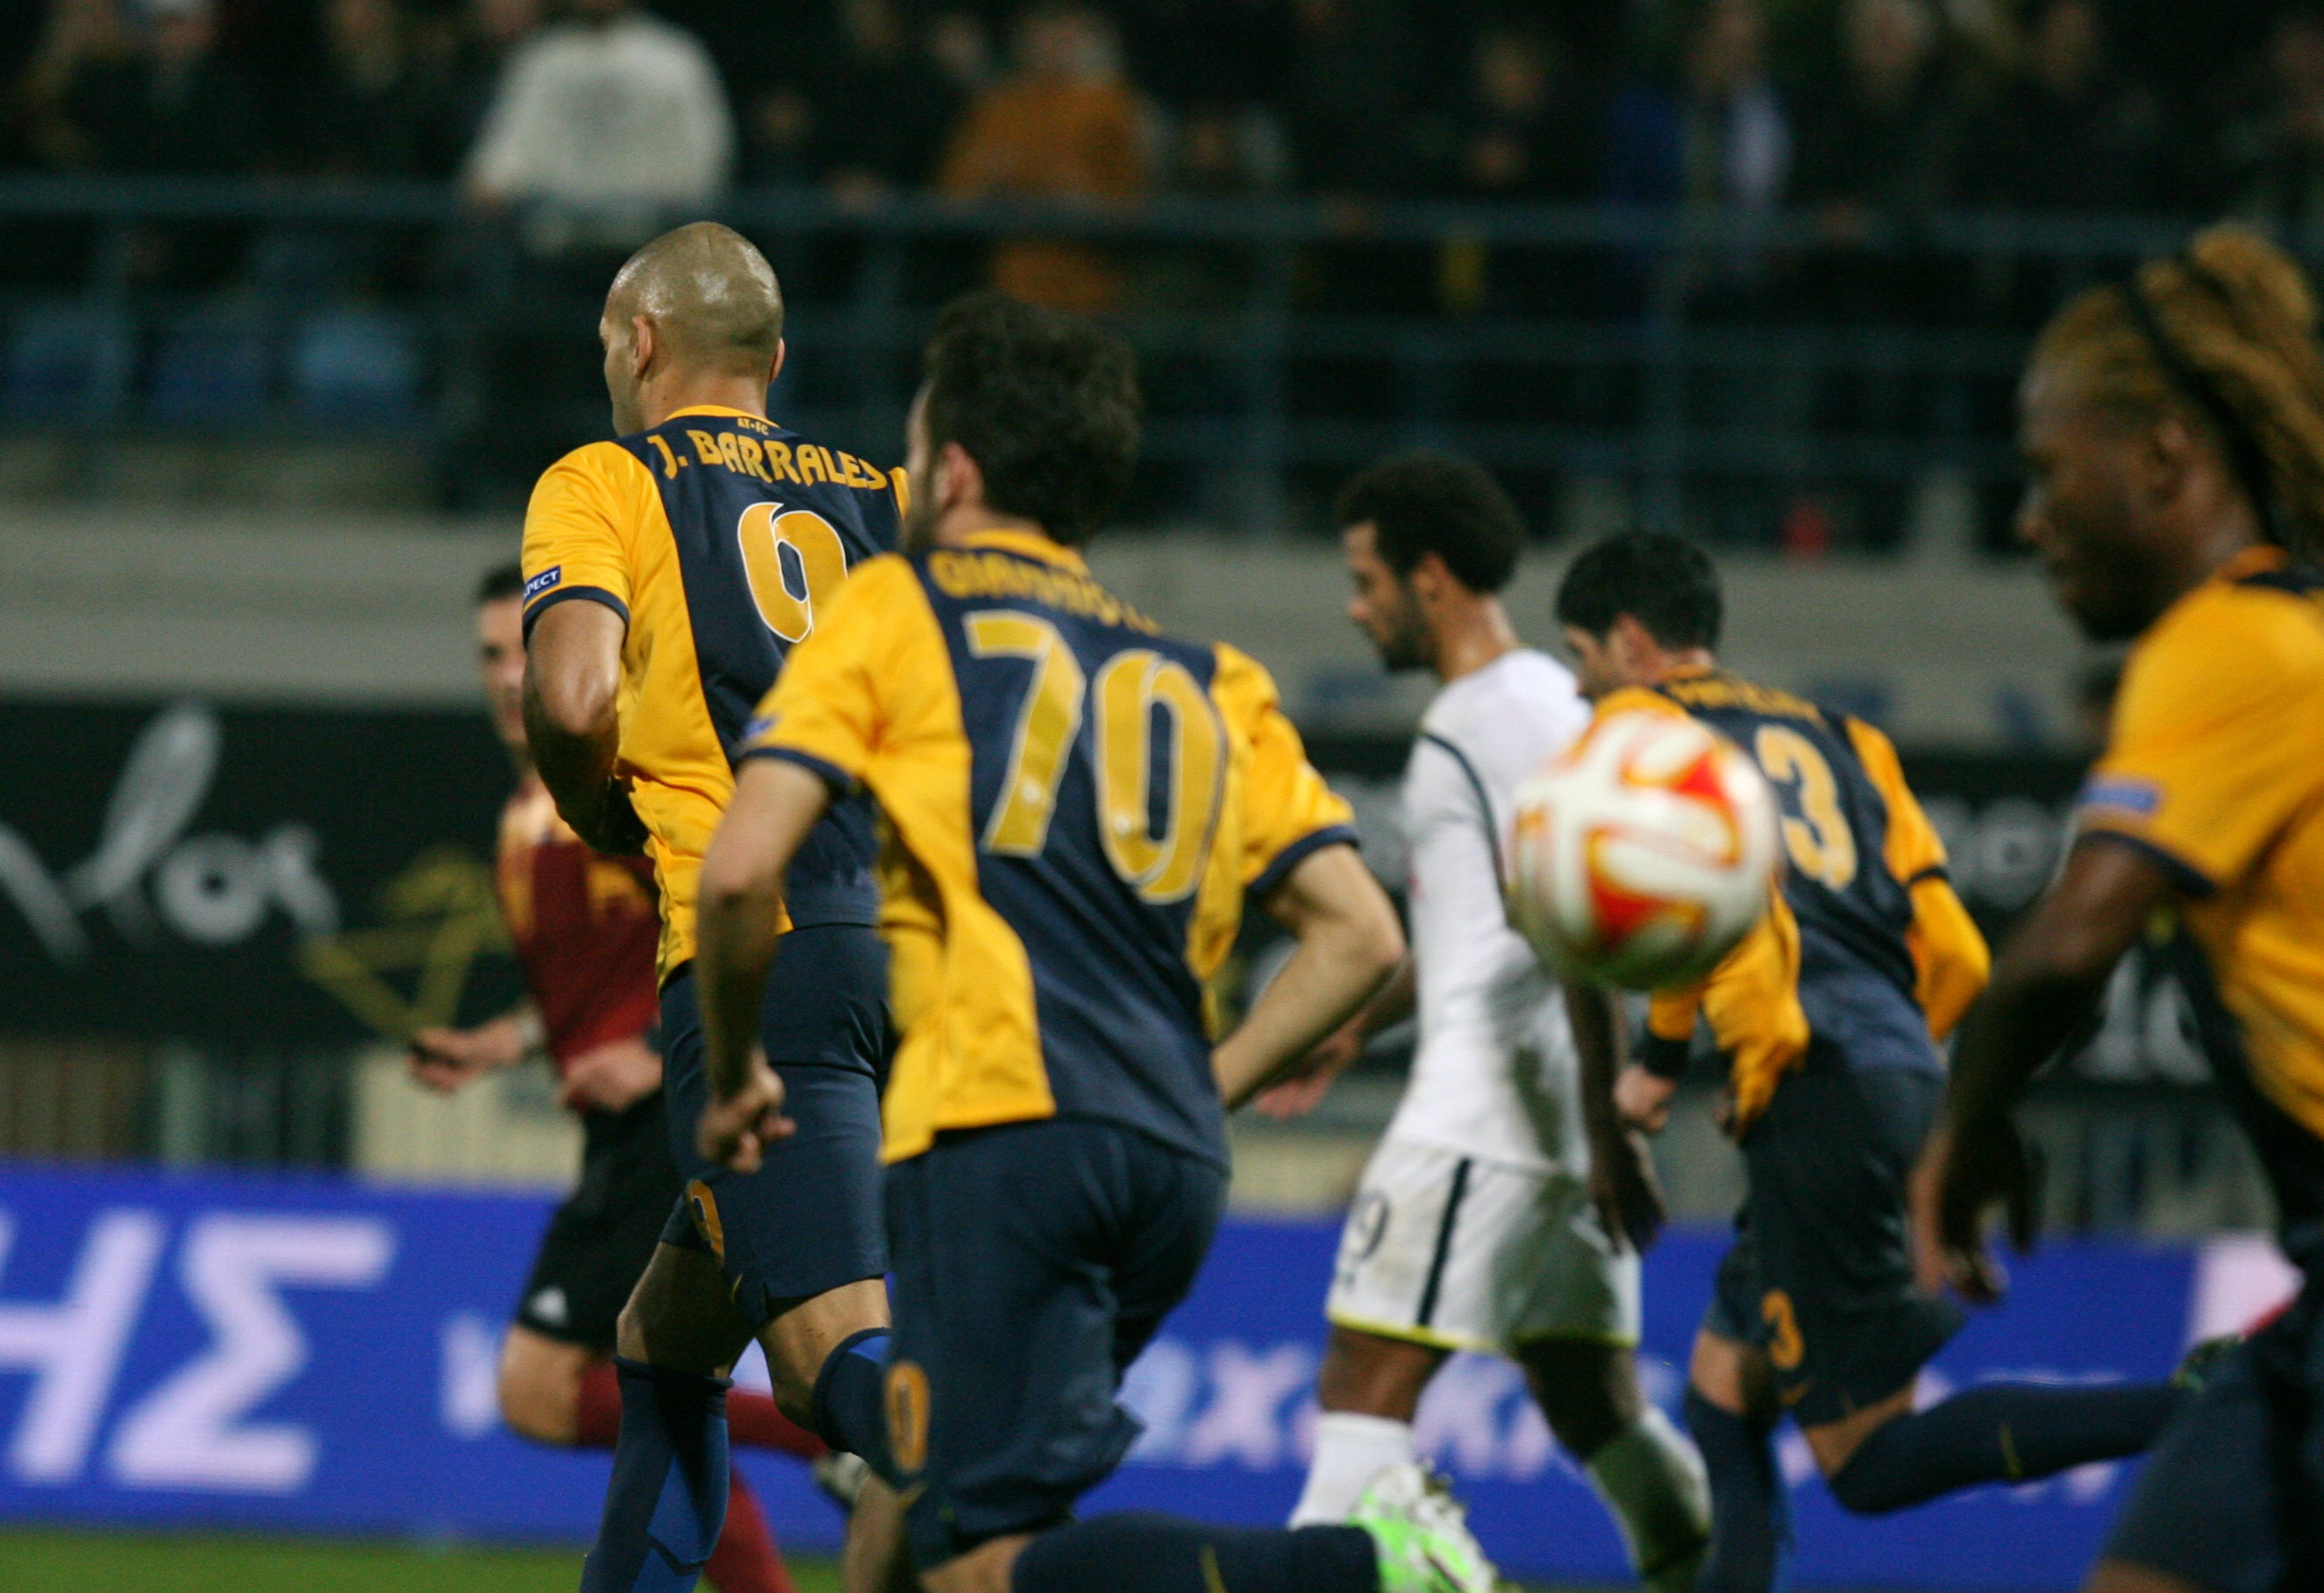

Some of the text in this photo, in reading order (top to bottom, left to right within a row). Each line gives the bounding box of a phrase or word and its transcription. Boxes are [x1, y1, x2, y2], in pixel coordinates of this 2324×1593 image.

[647, 434, 689, 480] J.
[524, 570, 560, 597] PECT
[961, 608, 1230, 905] 70
[1756, 723, 1859, 893] 3
[1761, 1289, 1805, 1371] 3
